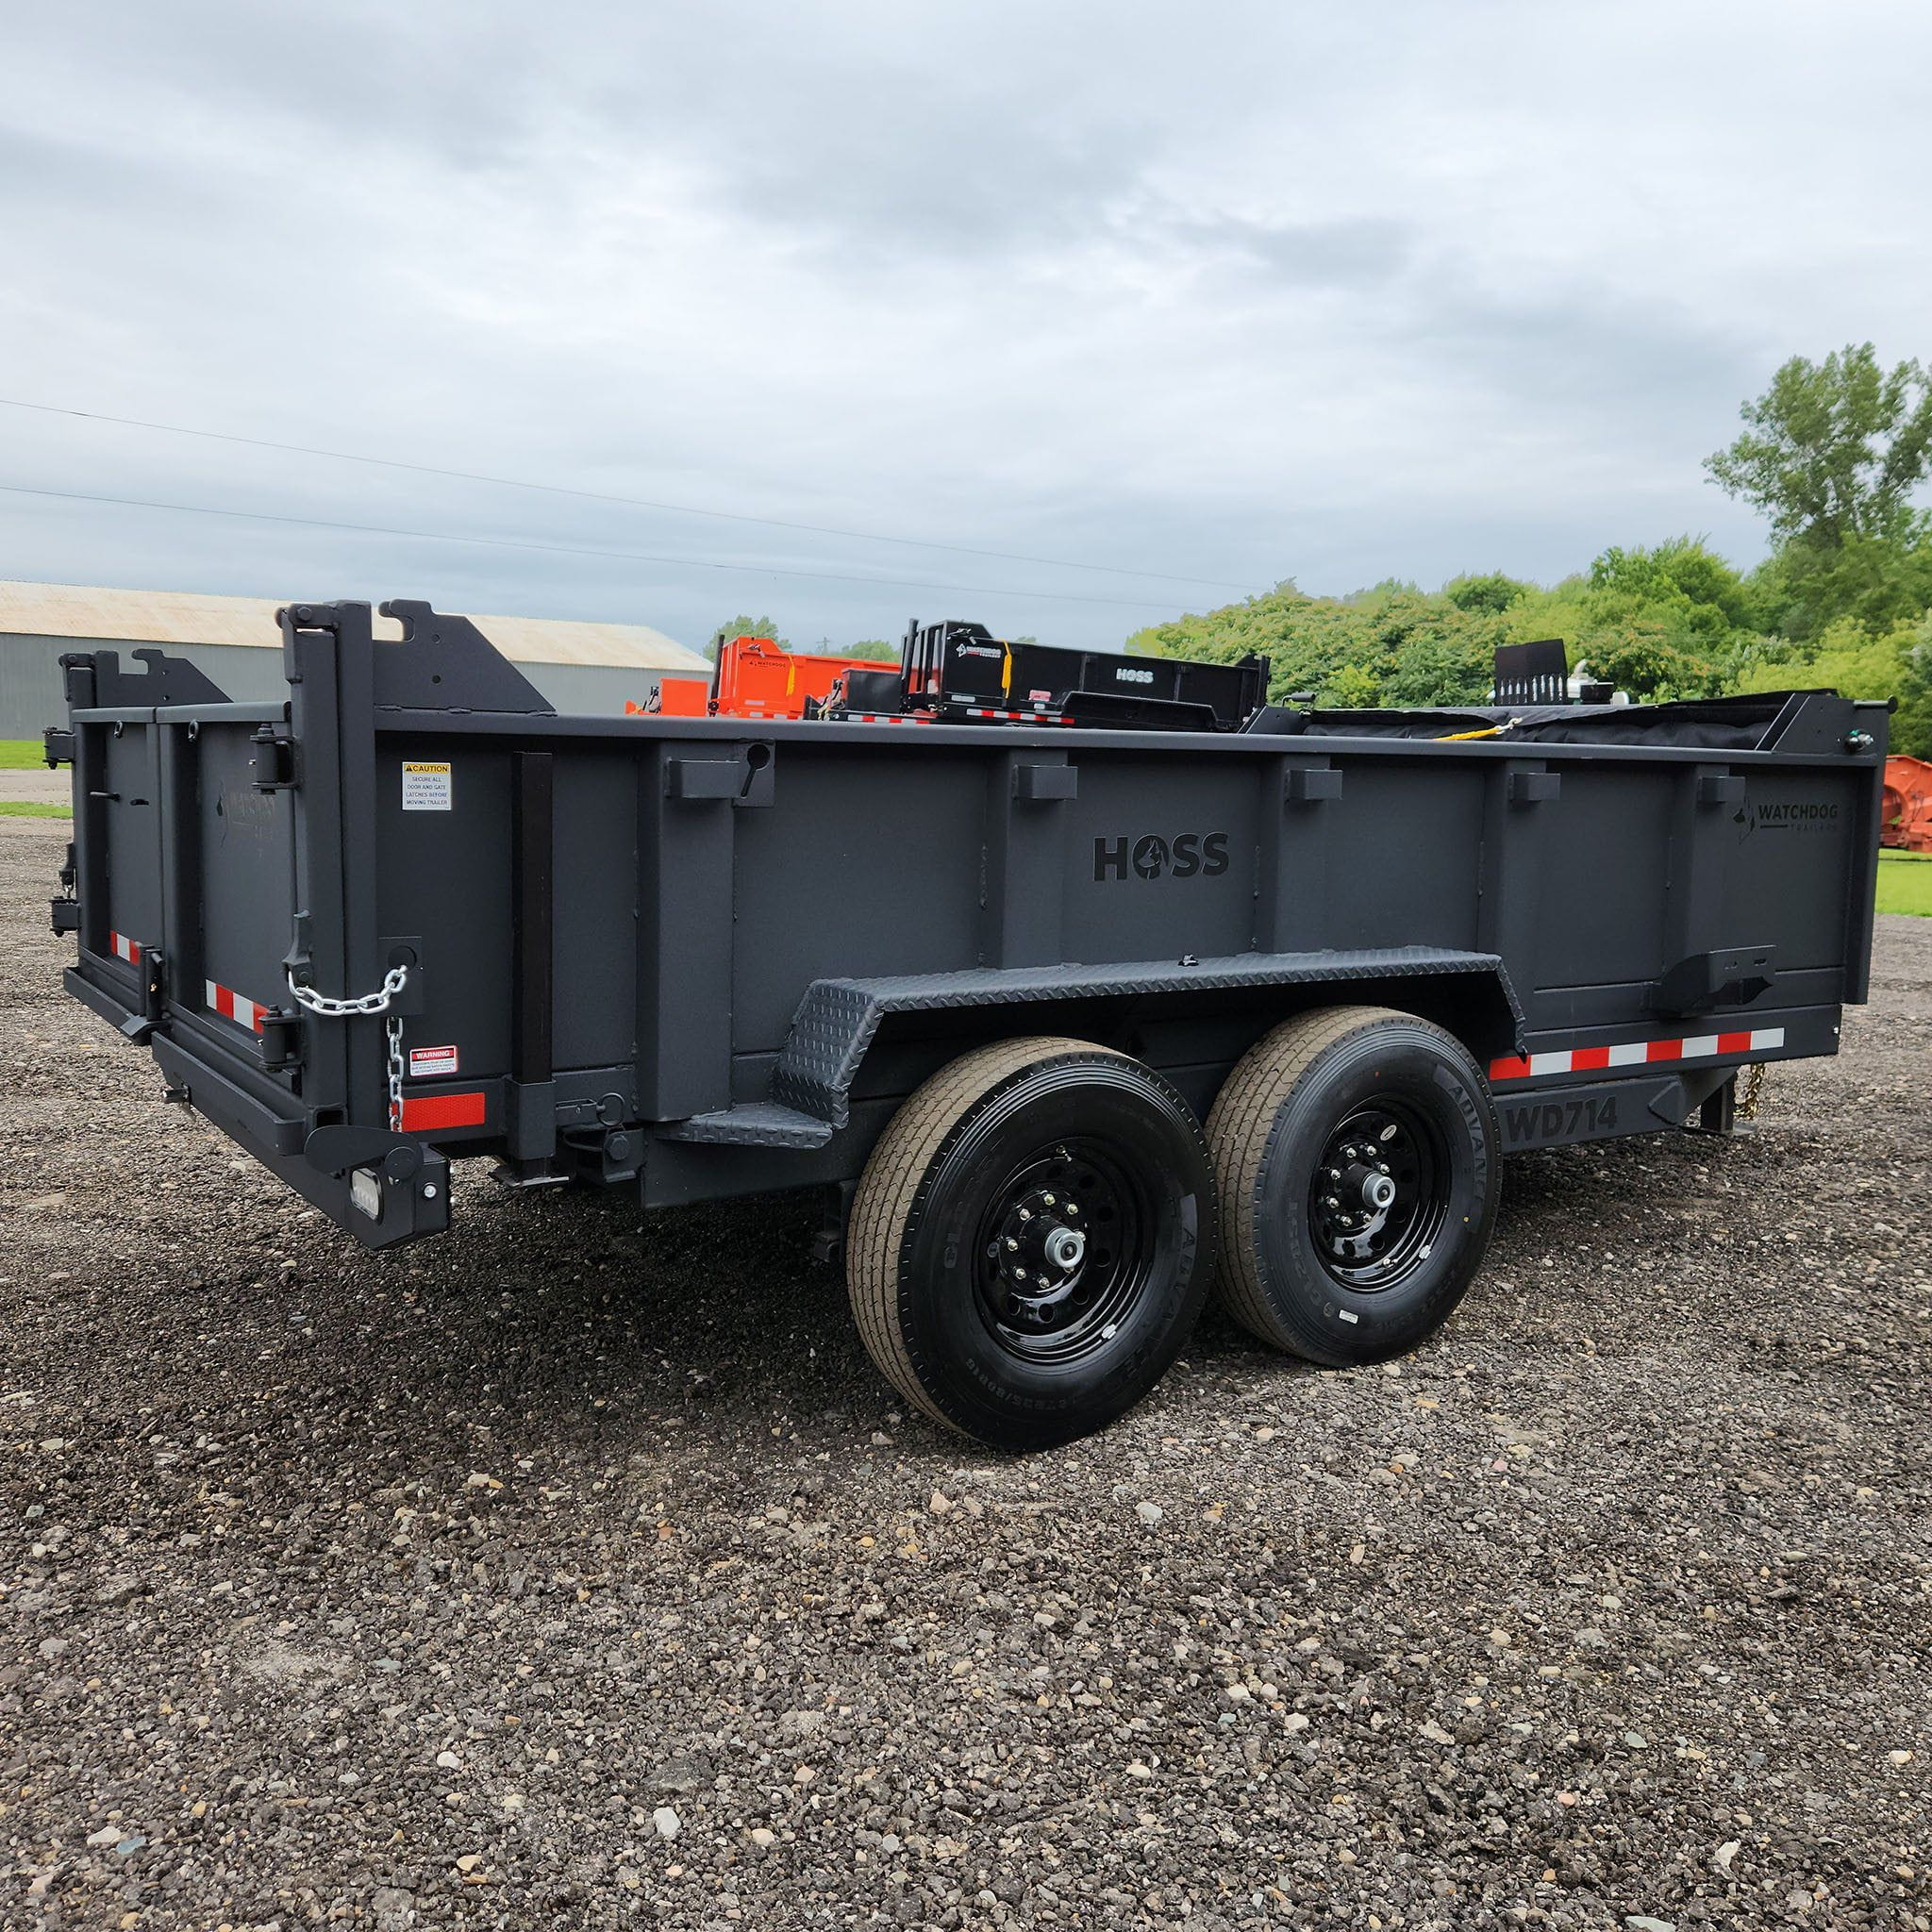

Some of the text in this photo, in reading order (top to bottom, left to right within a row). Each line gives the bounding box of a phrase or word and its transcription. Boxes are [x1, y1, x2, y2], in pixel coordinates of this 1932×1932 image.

[1116, 668, 1154, 684] HOSS
[1758, 804, 1839, 820] WATCHDOG
[1093, 831, 1229, 881] HOSS
[416, 1050, 450, 1059] WARNING
[1506, 1096, 1618, 1142] WD714
